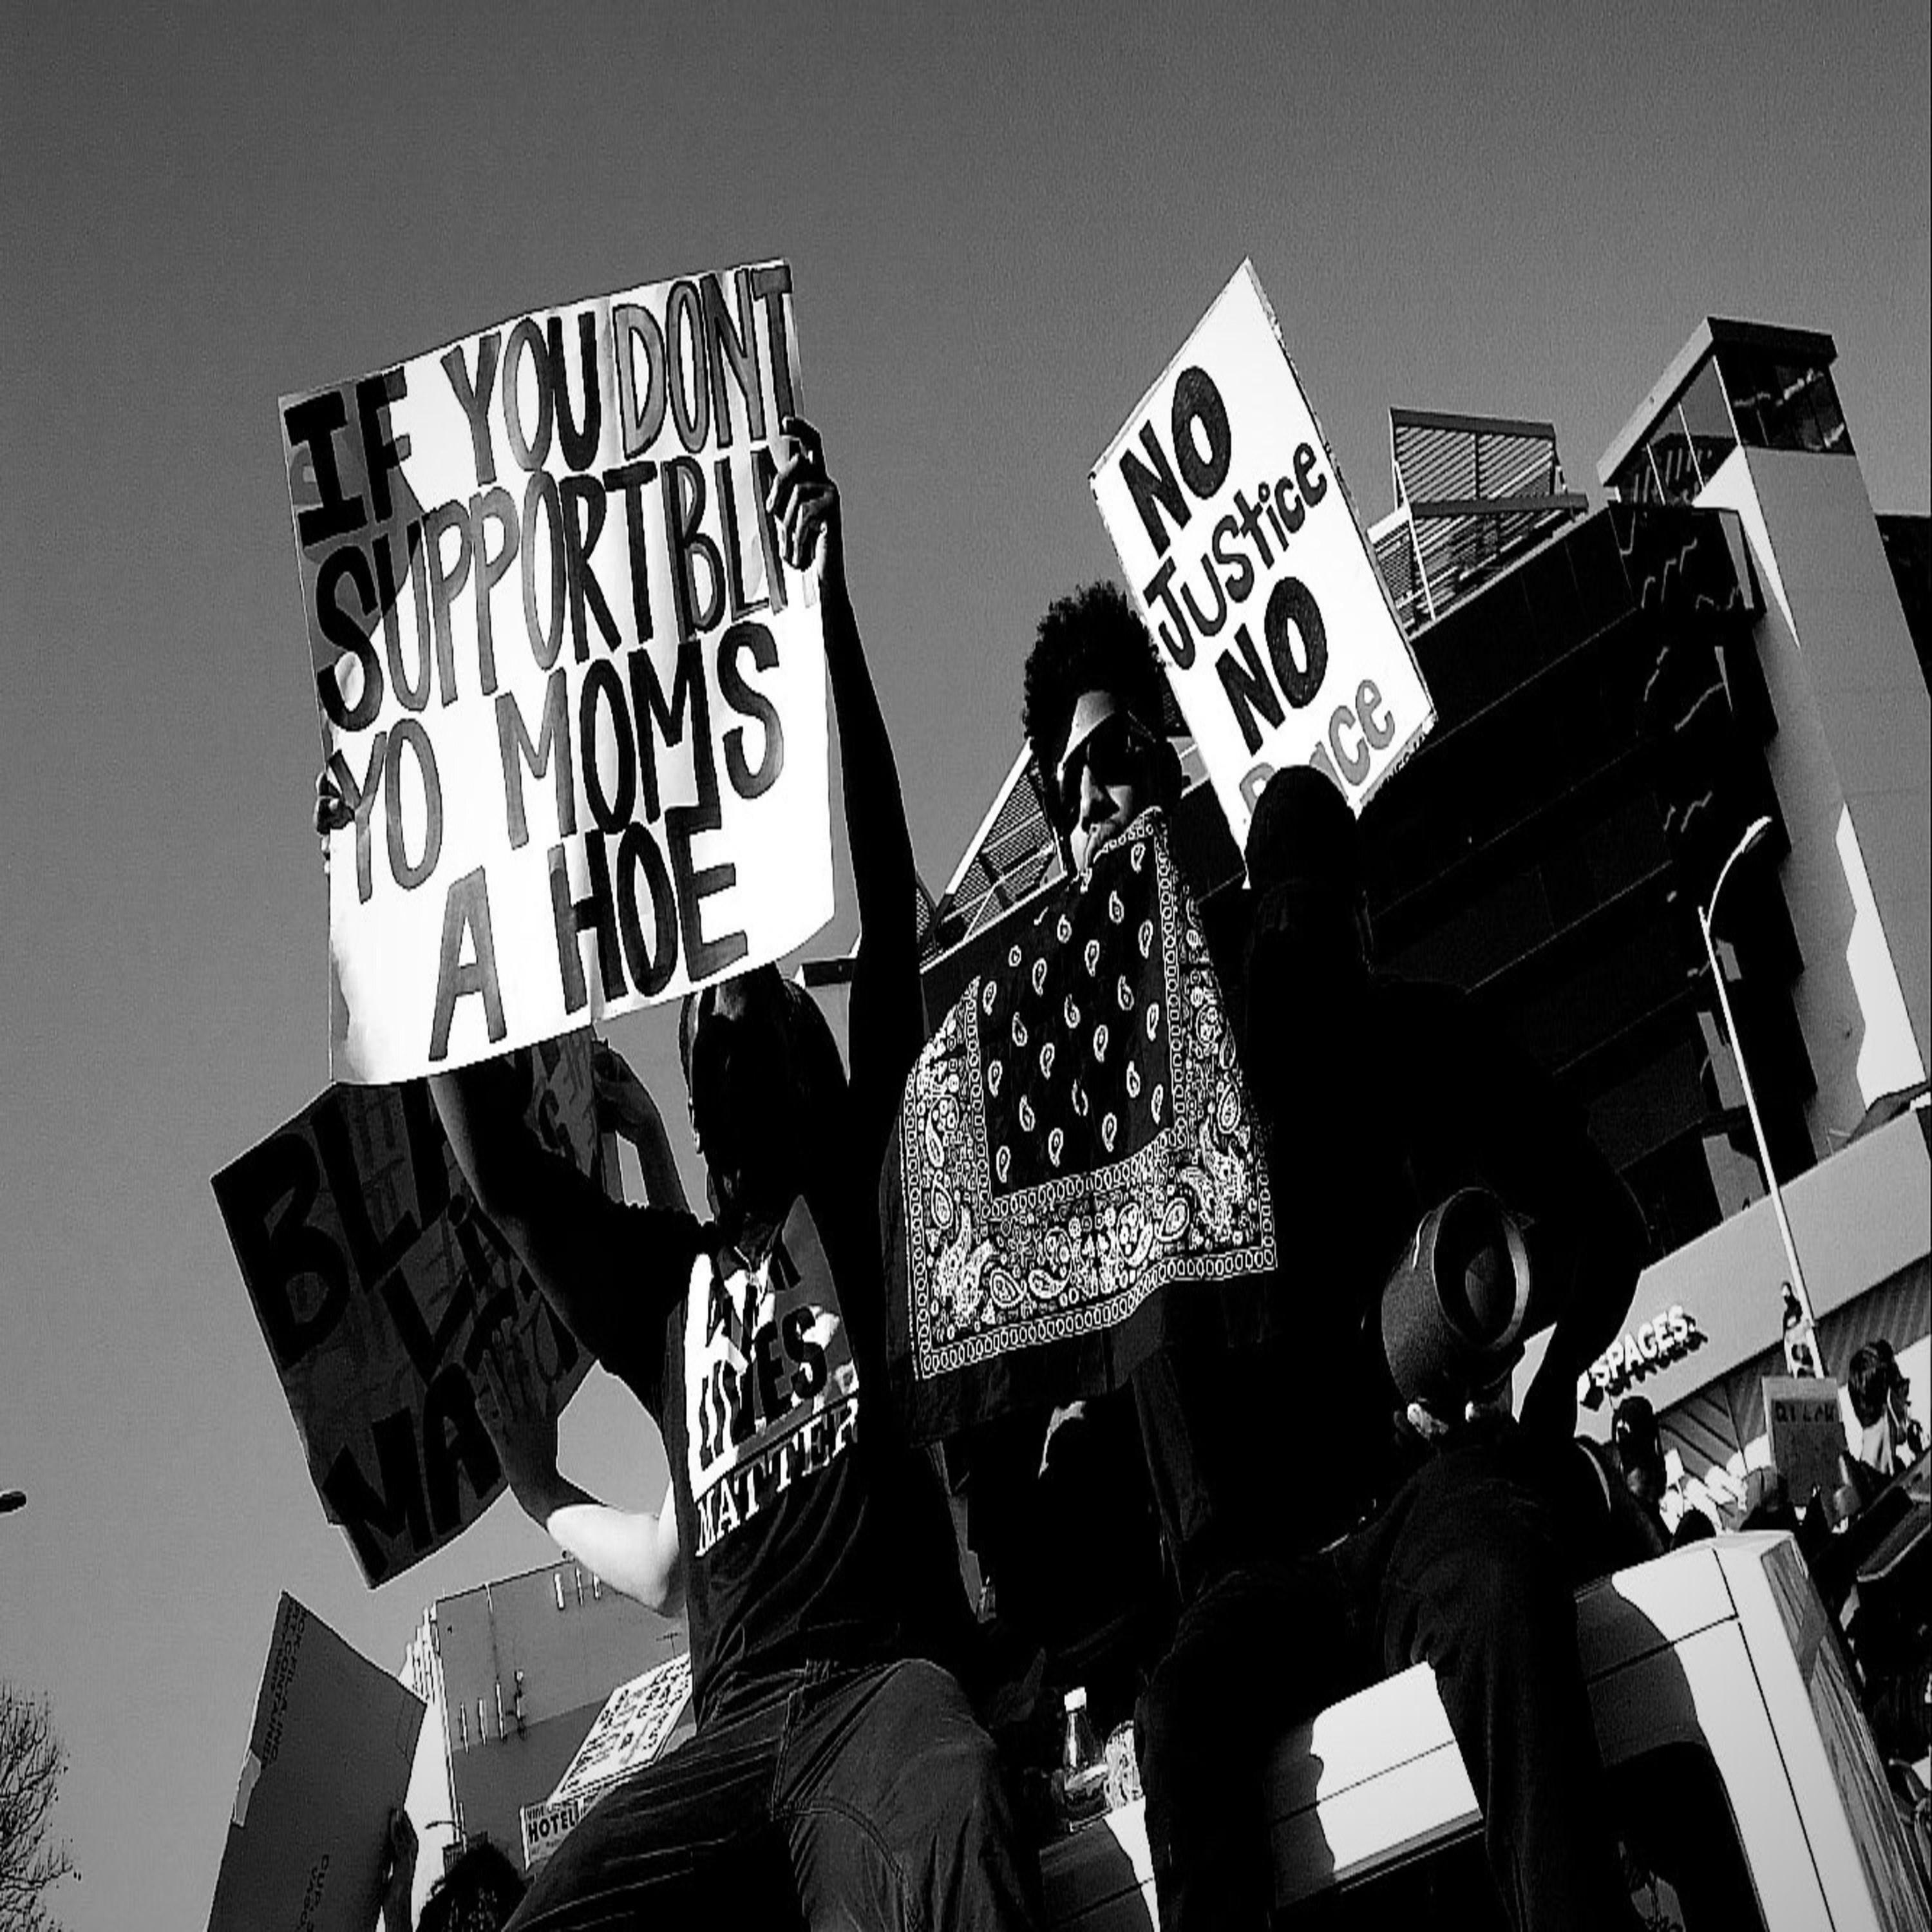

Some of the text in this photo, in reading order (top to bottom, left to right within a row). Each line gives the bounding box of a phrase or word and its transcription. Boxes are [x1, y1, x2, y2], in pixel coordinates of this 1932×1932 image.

[283, 265, 793, 549] IF YOU DONT
[1119, 365, 1231, 559] NO
[316, 461, 657, 732] SUPPORT
[1215, 576, 1328, 757] NO
[328, 621, 784, 902] YO MOMS
[429, 807, 749, 1063] A HOE
[529, 1808, 575, 1844] HOTEL
